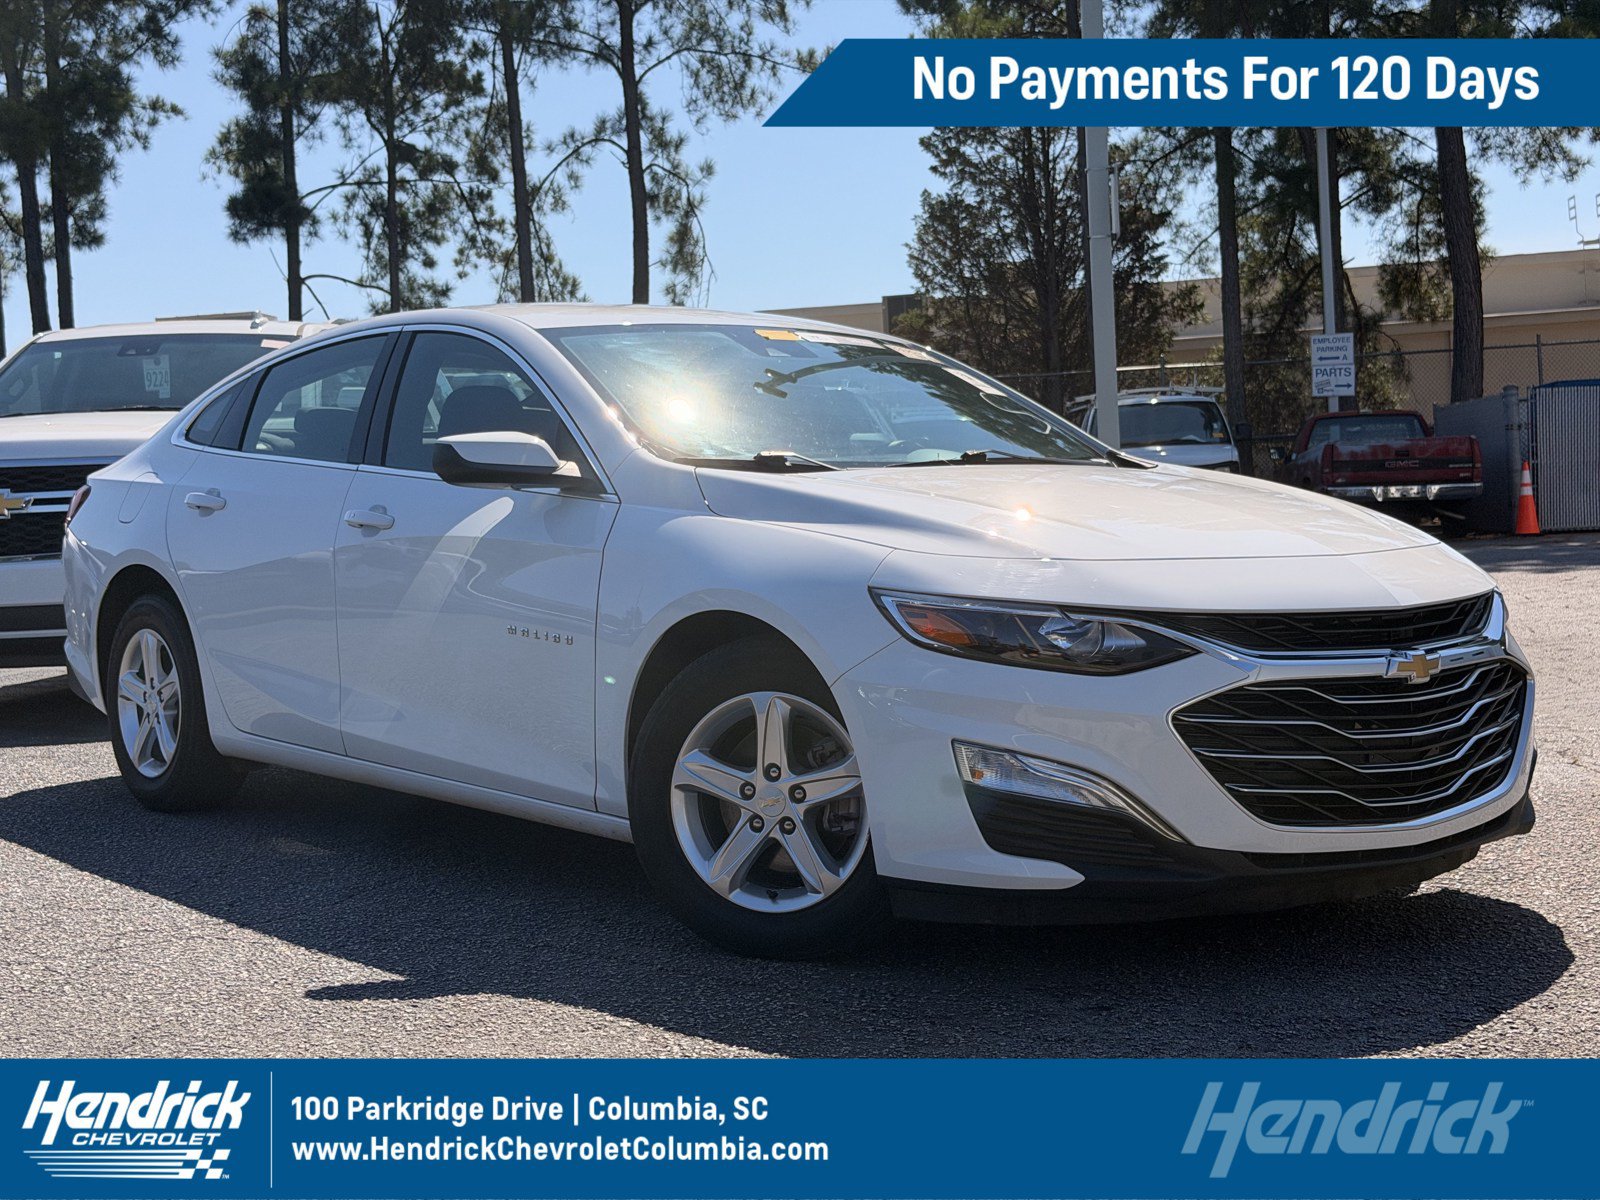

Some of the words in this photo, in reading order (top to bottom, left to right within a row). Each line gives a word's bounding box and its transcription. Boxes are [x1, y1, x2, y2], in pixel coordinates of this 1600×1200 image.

[1312, 336, 1351, 345] EMPLOYEE
[1316, 345, 1348, 353] PARKING
[1315, 367, 1352, 378] PARTS
[1384, 460, 1420, 468] GMC
[506, 624, 574, 646] MALIBU
